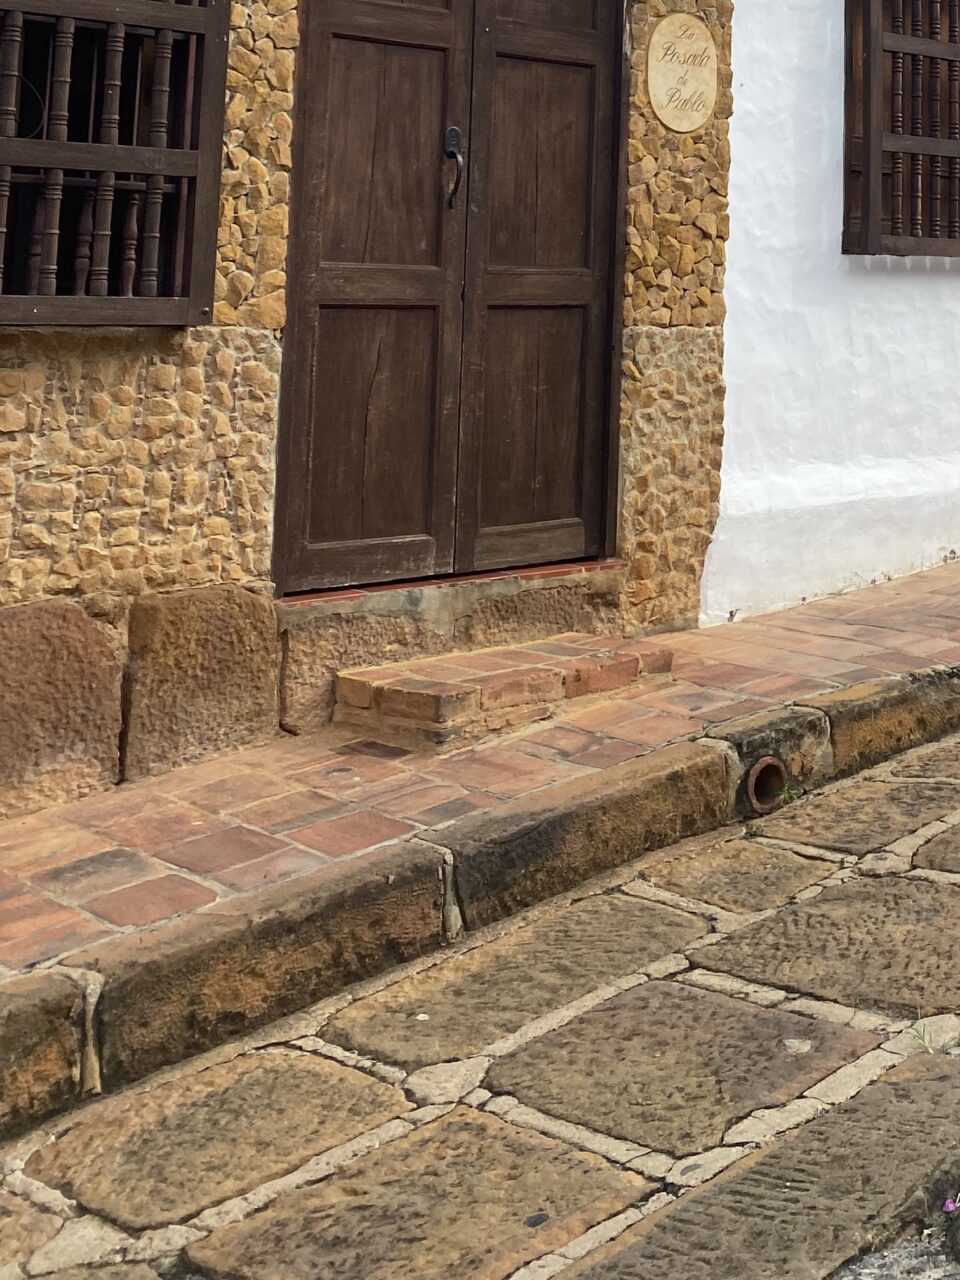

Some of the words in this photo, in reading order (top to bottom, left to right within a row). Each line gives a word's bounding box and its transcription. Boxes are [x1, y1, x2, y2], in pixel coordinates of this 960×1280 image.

[674, 23, 695, 39] La
[656, 40, 711, 67] Posada
[677, 70, 689, 87] de
[660, 87, 706, 113] Pablo
